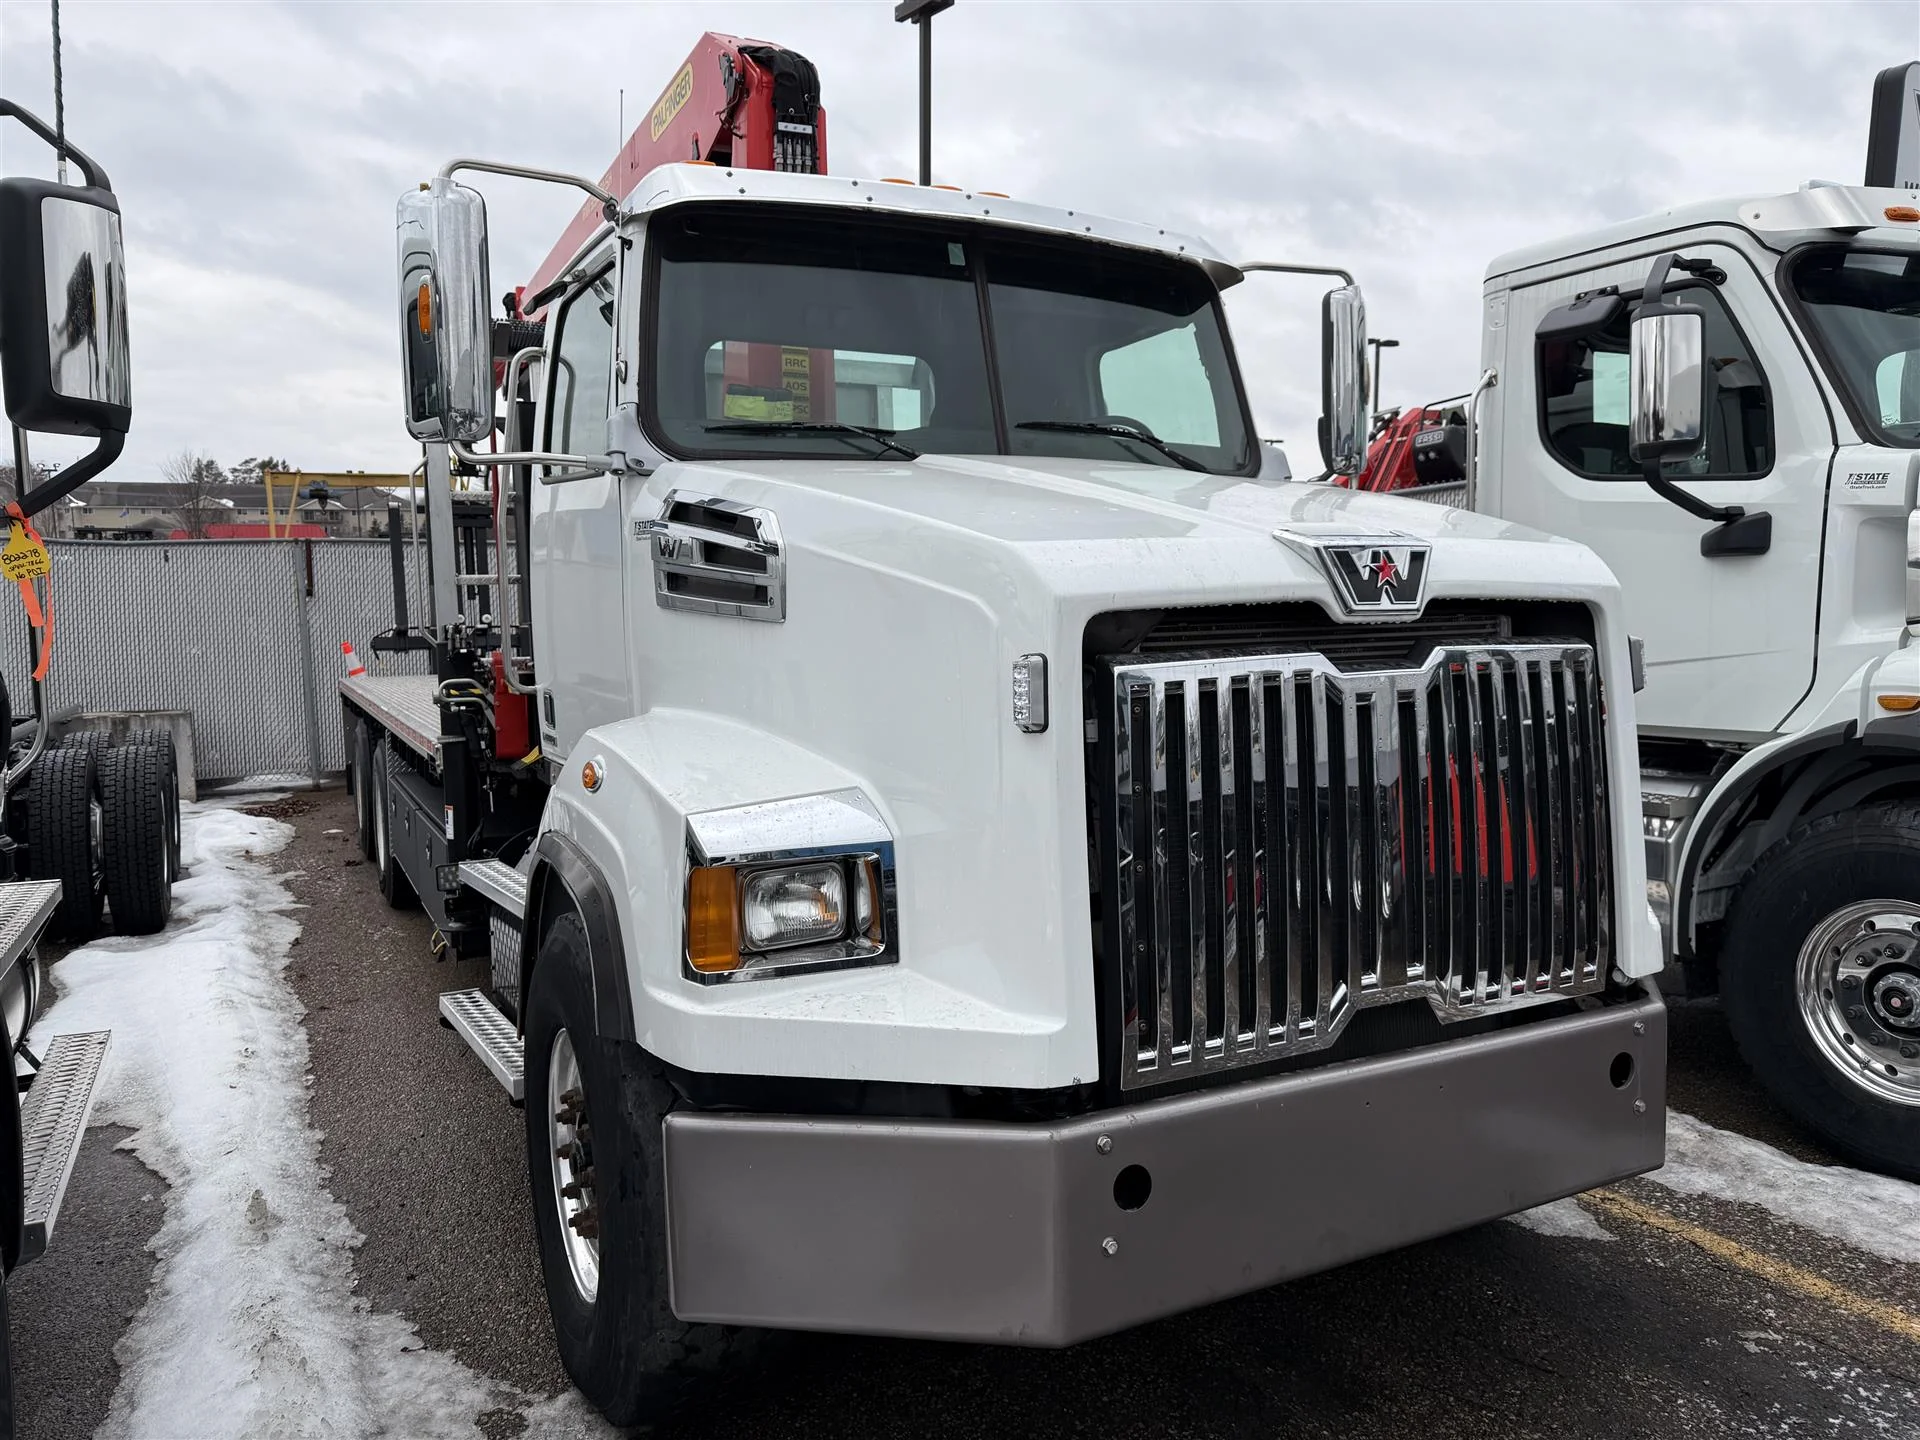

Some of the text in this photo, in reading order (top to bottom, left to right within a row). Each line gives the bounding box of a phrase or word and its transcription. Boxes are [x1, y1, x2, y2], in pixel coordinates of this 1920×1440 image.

[653, 70, 691, 136] PALFINGER
[785, 357, 807, 368] RRC
[786, 382, 807, 391] AOS
[1, 548, 41, 565] 802278
